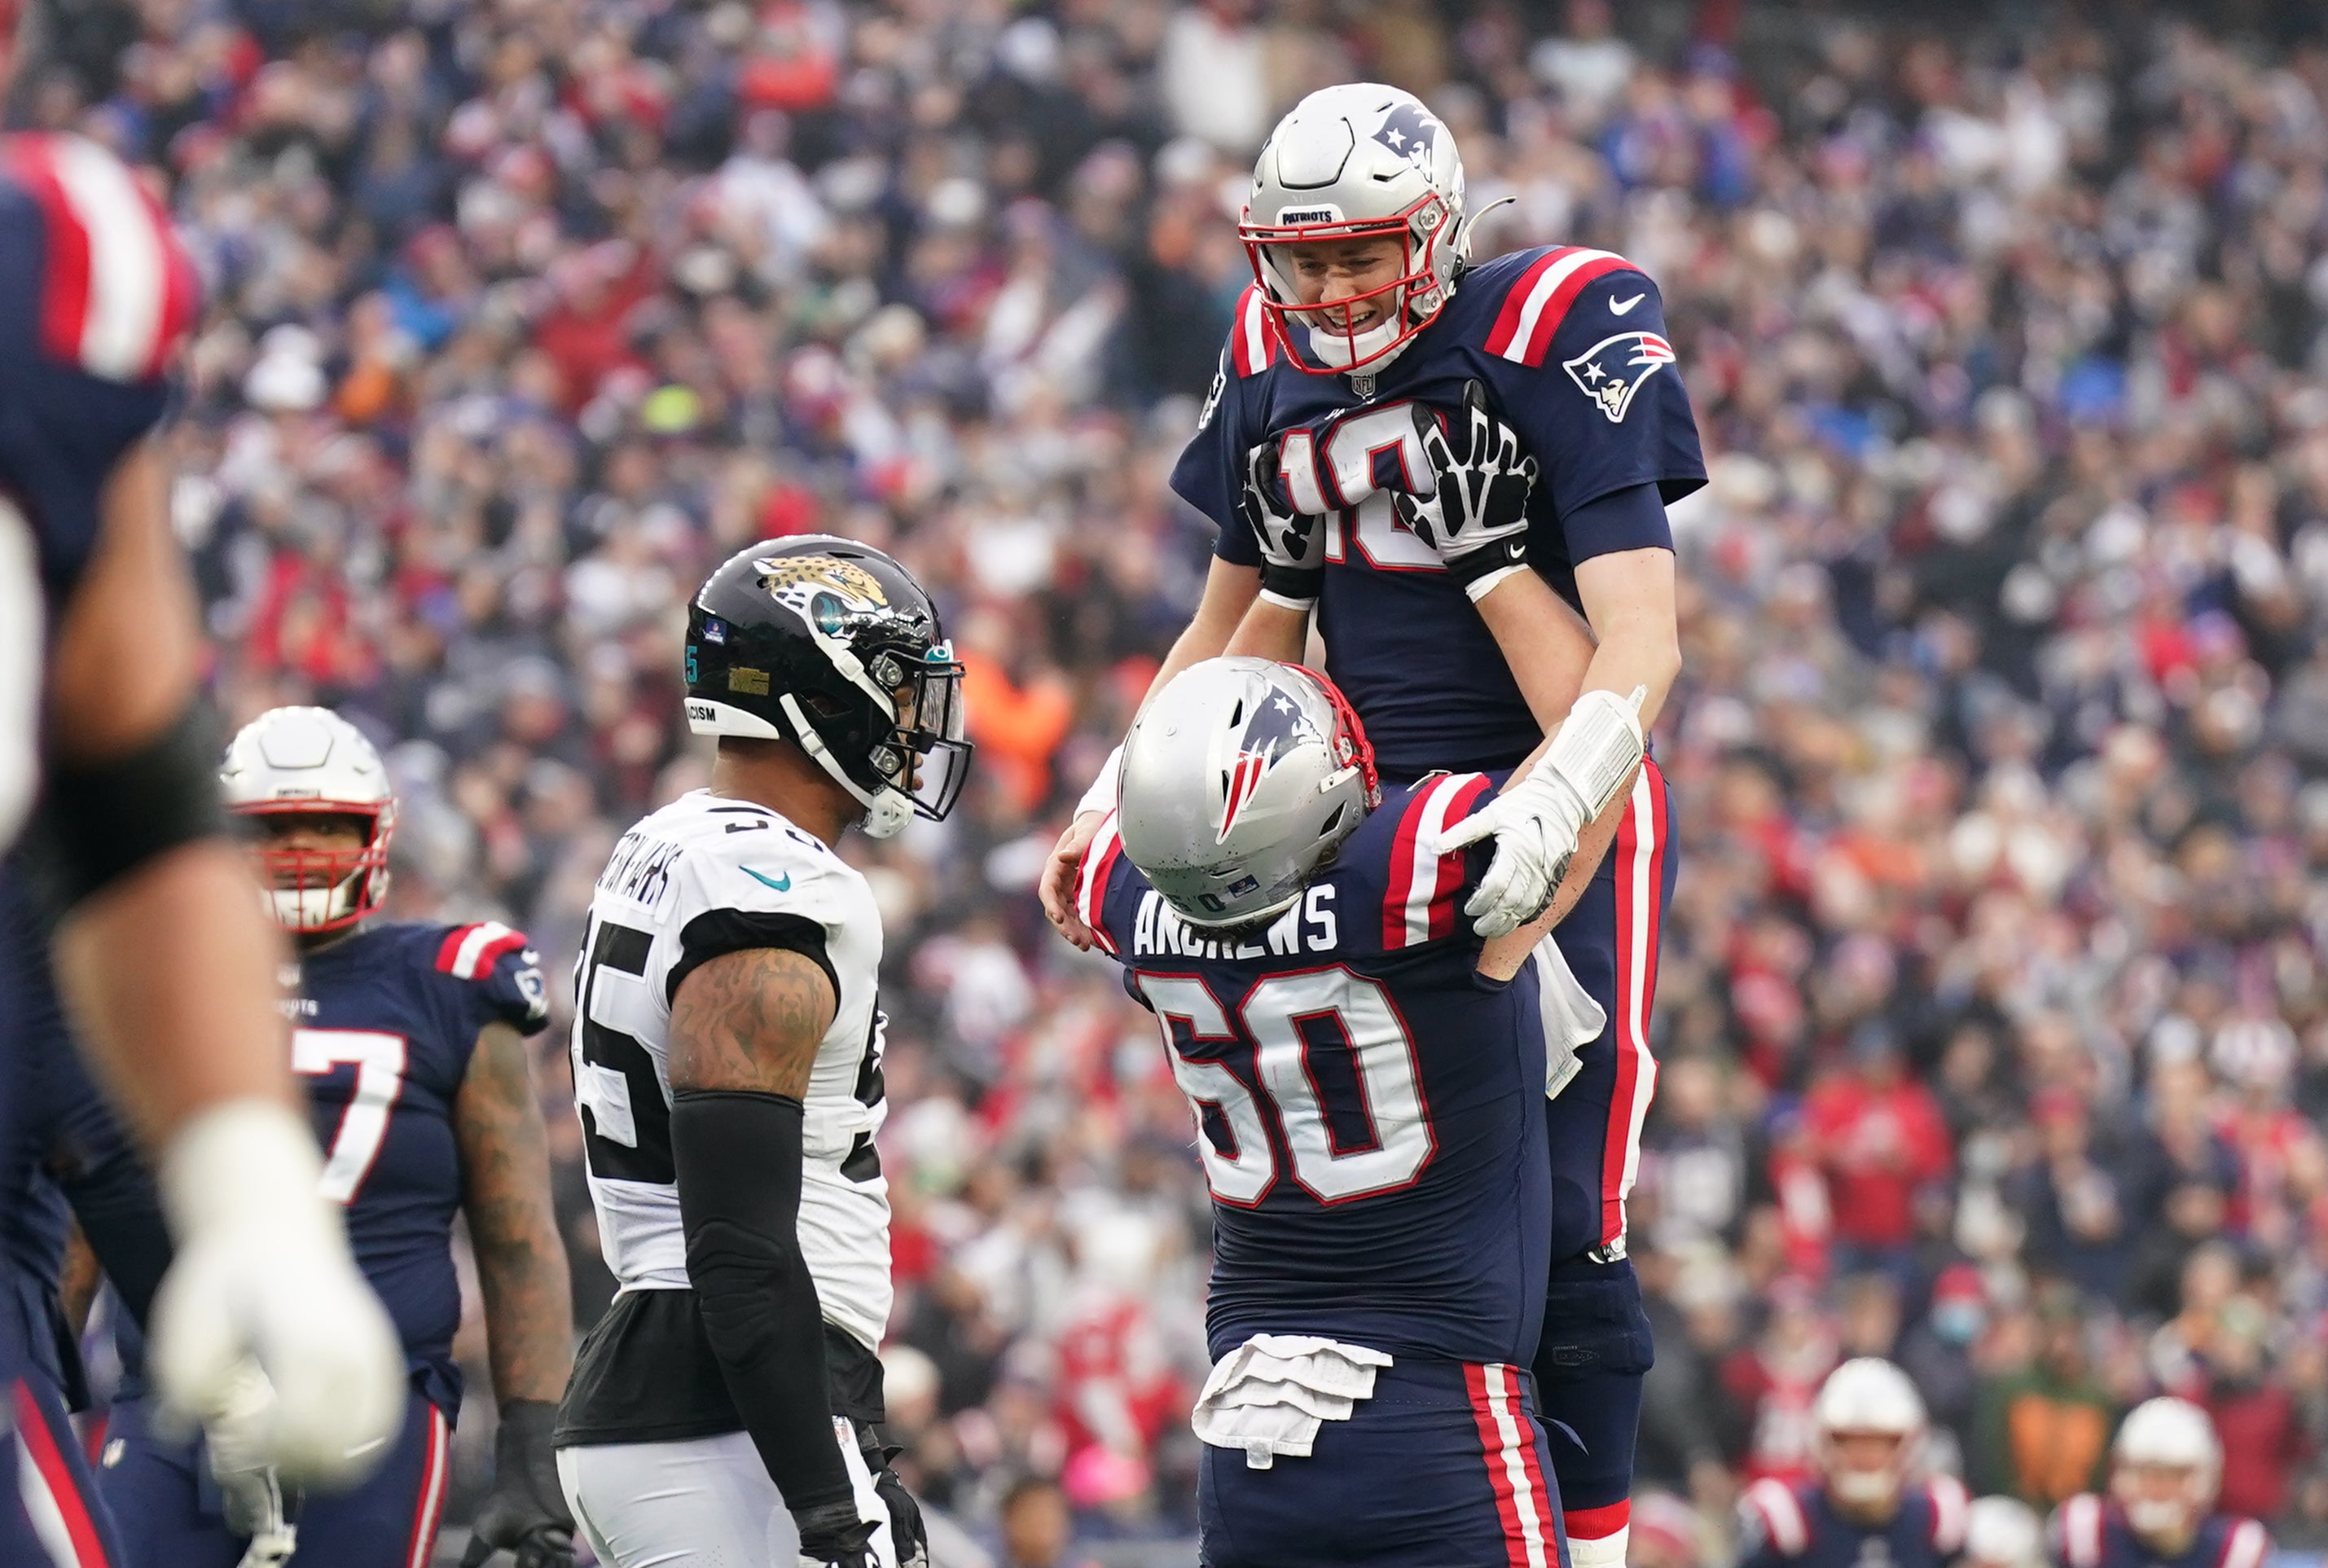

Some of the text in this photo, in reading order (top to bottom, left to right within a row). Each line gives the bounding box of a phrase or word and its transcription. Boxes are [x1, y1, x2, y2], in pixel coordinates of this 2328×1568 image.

[1282, 211, 1333, 226] PATRIOTS
[1355, 378, 1373, 391] NFL
[1279, 399, 1449, 572] 10
[1134, 962, 1439, 1209] 60
